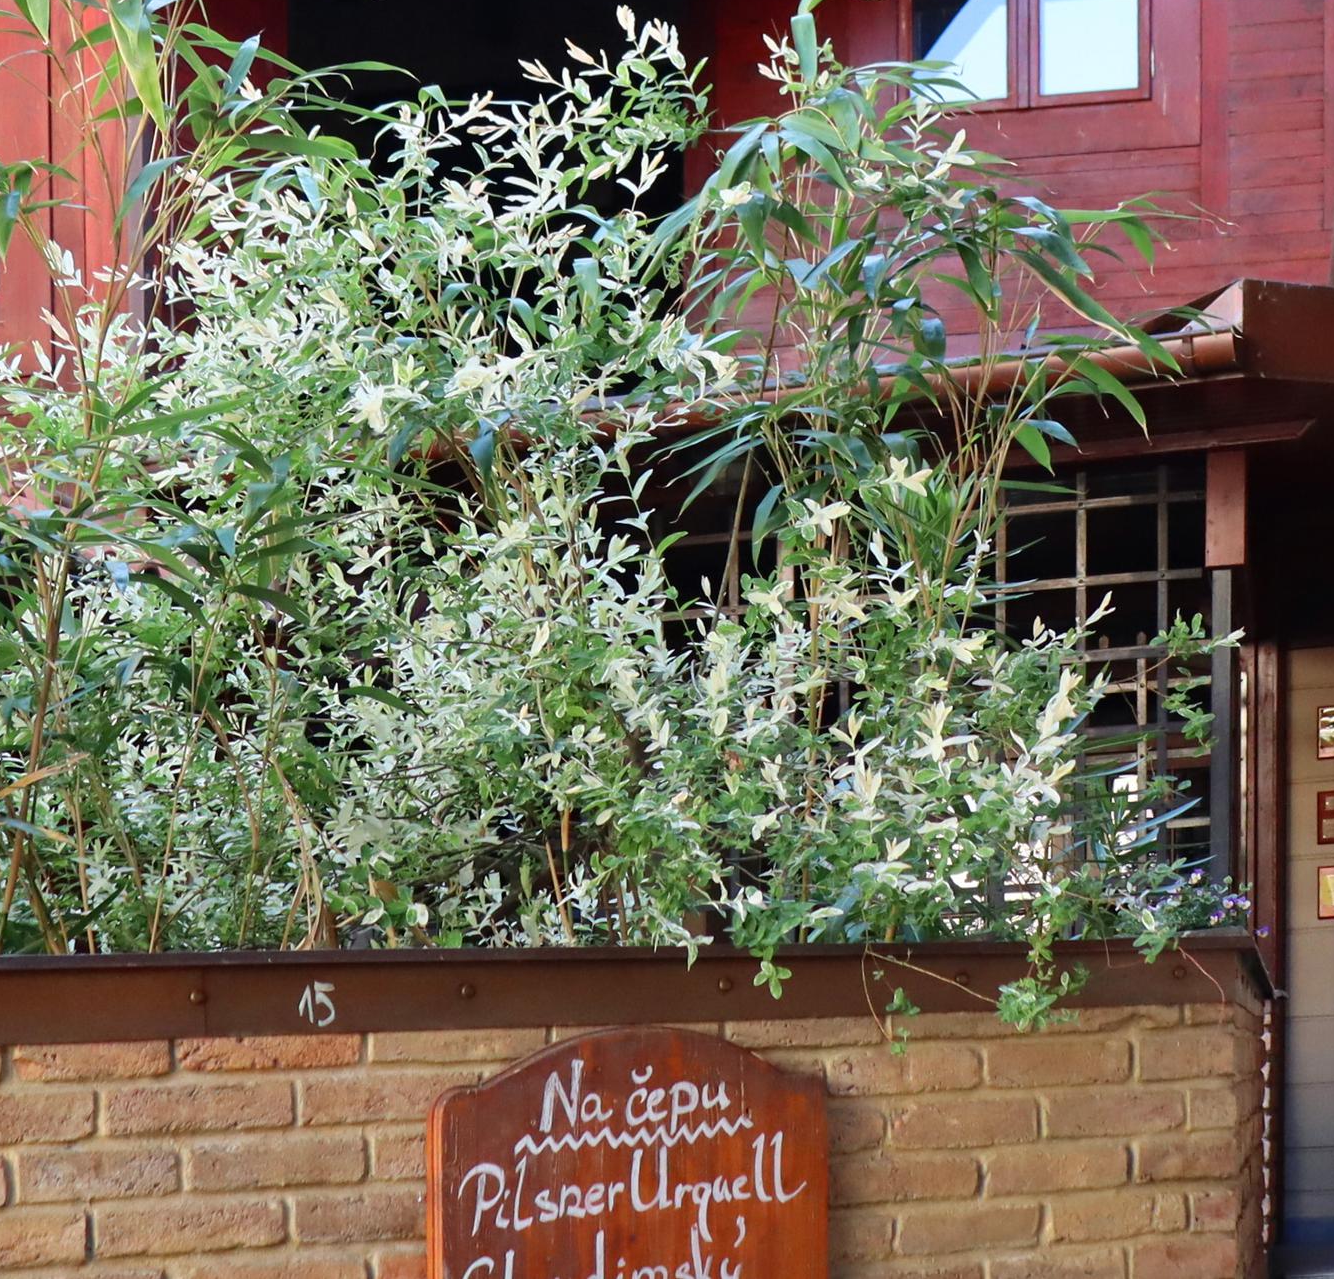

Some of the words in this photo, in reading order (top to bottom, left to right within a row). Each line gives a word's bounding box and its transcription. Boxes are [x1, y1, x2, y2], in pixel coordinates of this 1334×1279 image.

[298, 980, 336, 1027] 15
[539, 1058, 614, 1133] Na
[625, 1064, 731, 1136] čepu
[630, 1130, 807, 1242] Urquell
